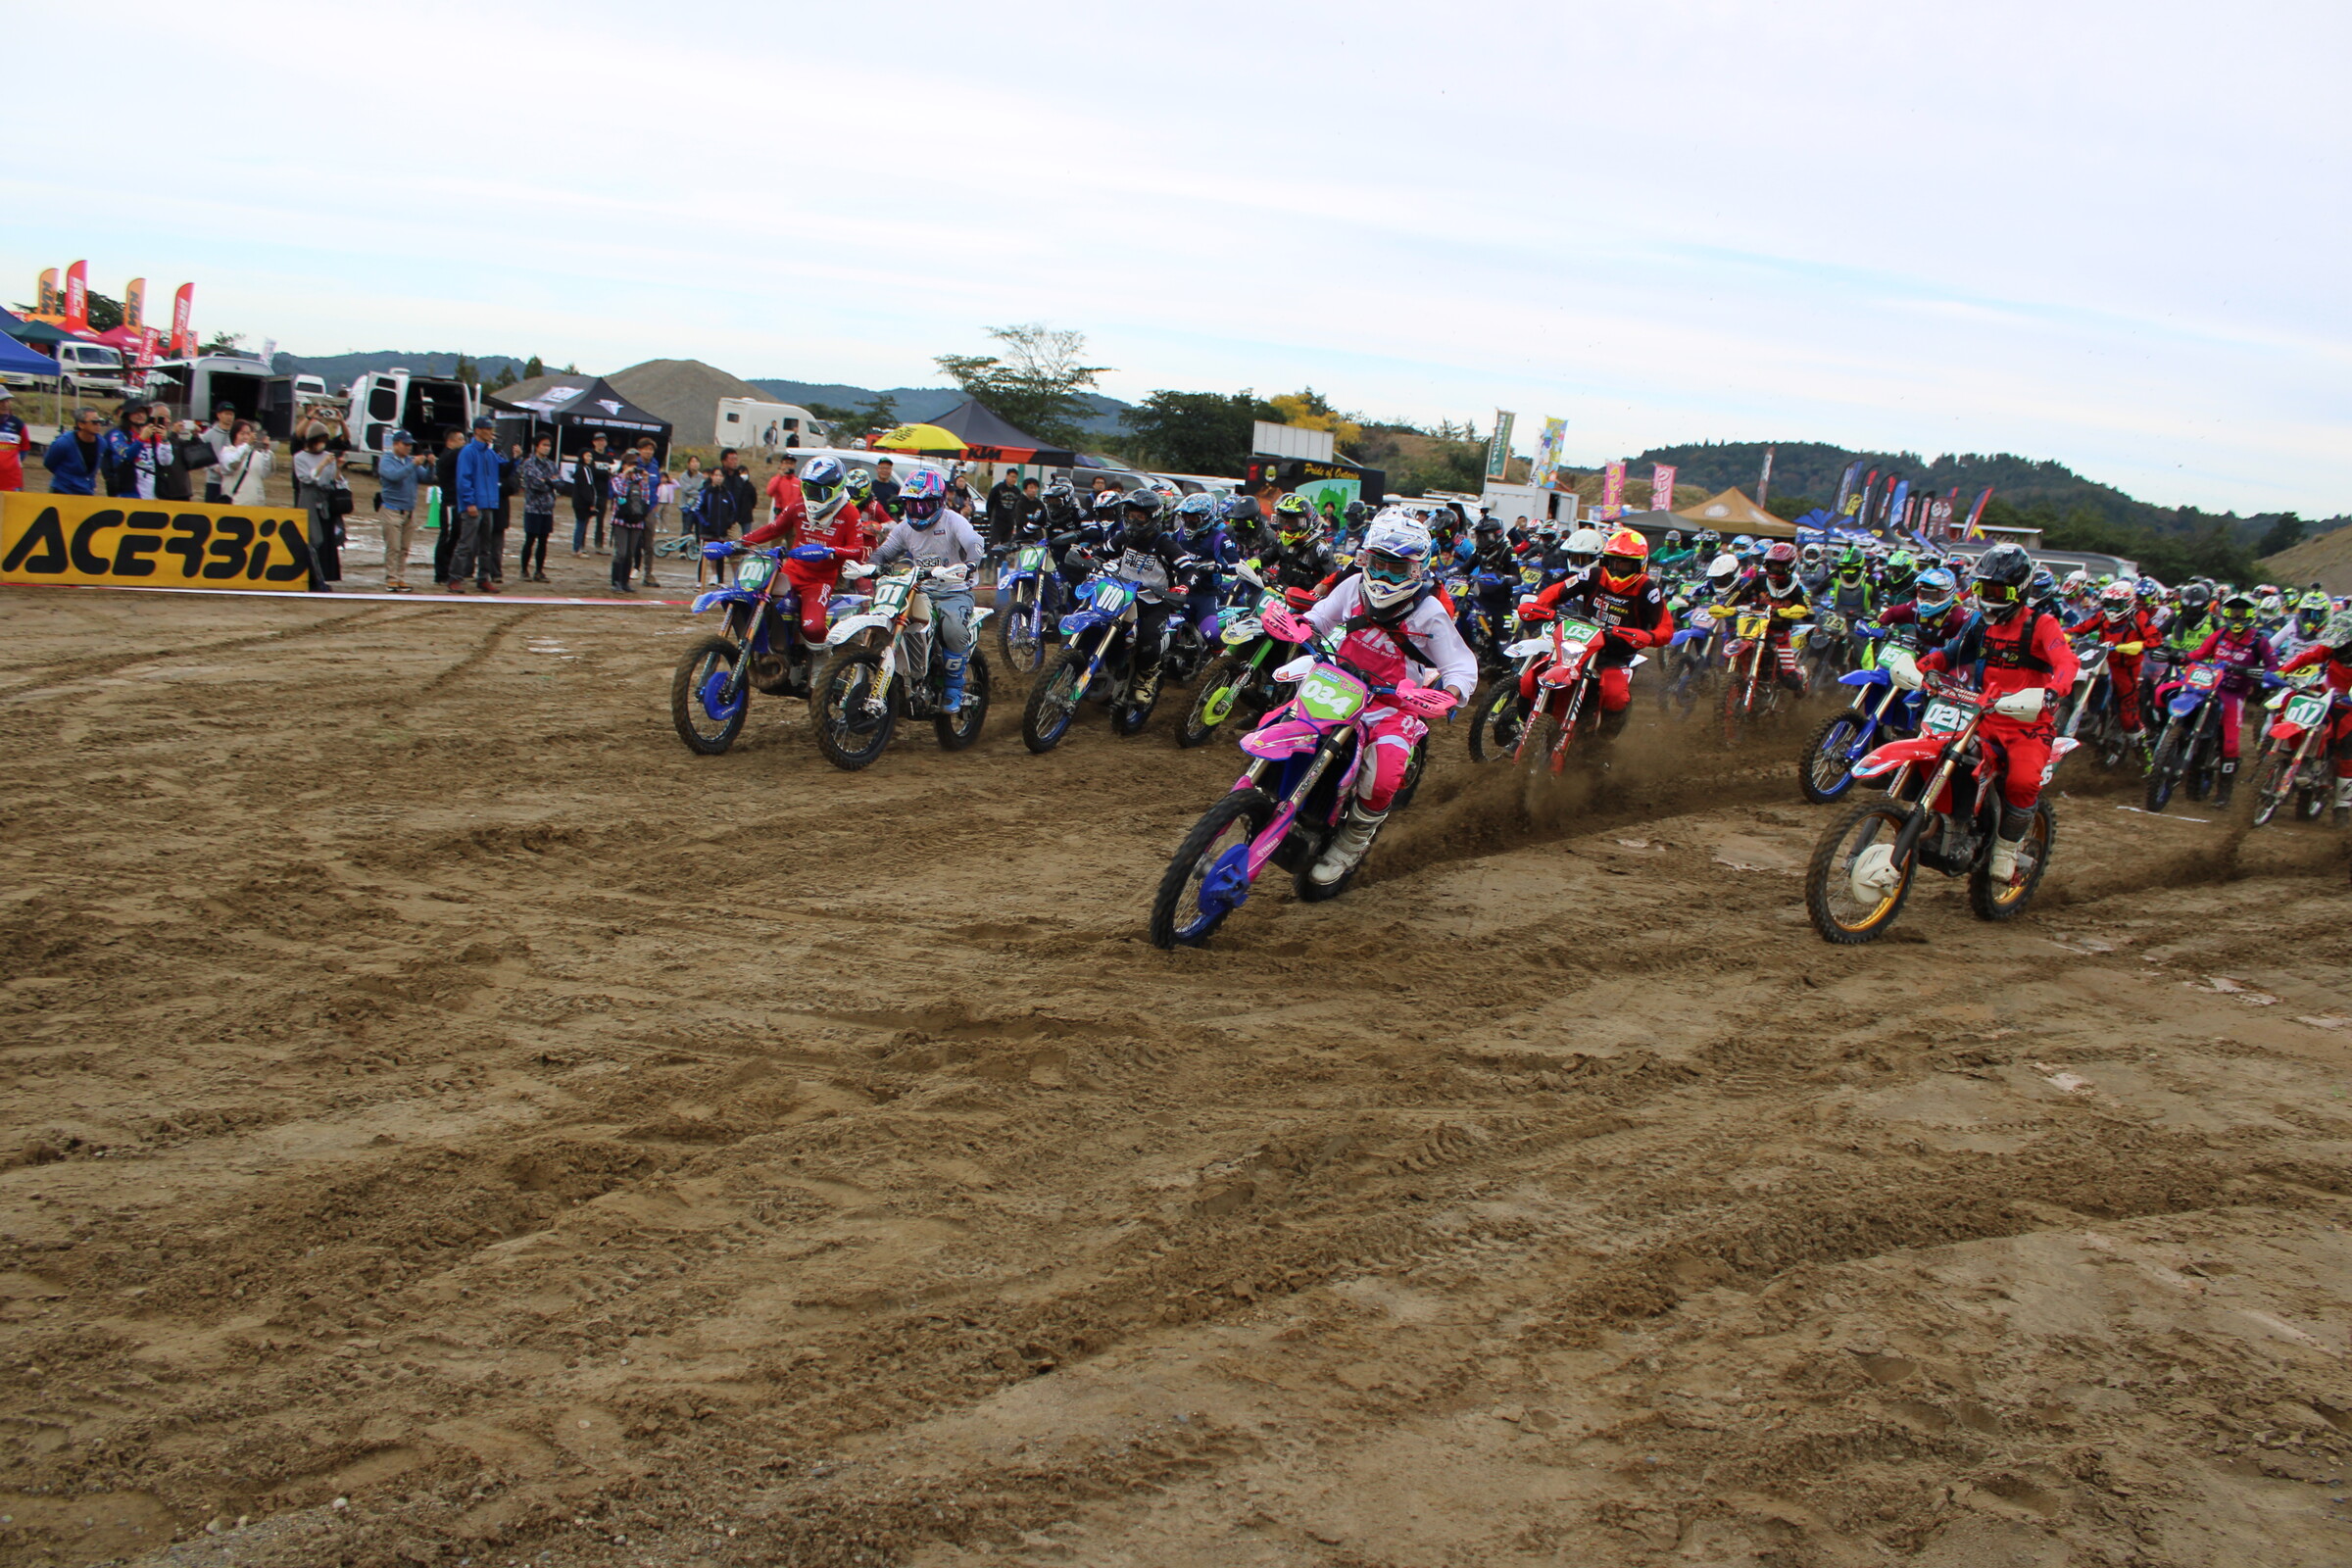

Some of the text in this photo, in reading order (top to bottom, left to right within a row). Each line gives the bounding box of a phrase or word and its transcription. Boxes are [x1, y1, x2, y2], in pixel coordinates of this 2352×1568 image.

[966, 446, 1003, 462] KTM
[2, 507, 308, 581] ACERBIS
[1124, 560, 1154, 572] RACNG
[874, 585, 904, 605] 01
[1097, 585, 1125, 612] 010
[1565, 625, 1593, 640] 03
[946, 658, 963, 671] G
[1300, 680, 1353, 715] 034
[1923, 703, 1975, 732] 026
[2286, 701, 2324, 724] 017
[2221, 762, 2236, 774] G
